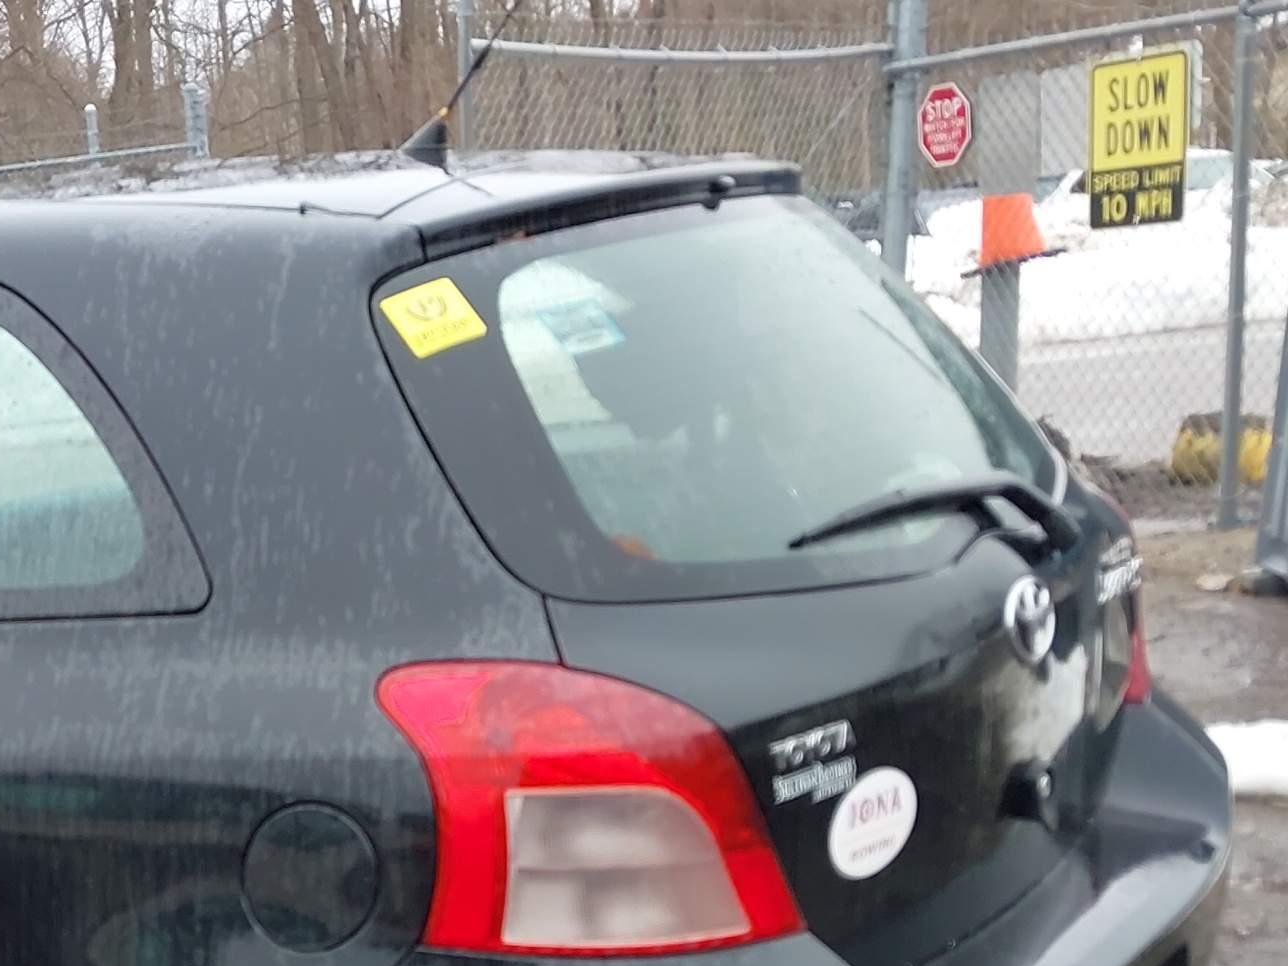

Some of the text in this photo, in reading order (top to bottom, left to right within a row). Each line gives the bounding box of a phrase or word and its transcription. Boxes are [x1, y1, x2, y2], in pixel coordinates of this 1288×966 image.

[1108, 69, 1170, 112] SLOW
[925, 96, 963, 122] STOP
[1106, 115, 1171, 158] DOWN
[1094, 164, 1182, 193] SPEED LIMIT
[1101, 188, 1173, 224] 10 MPH
